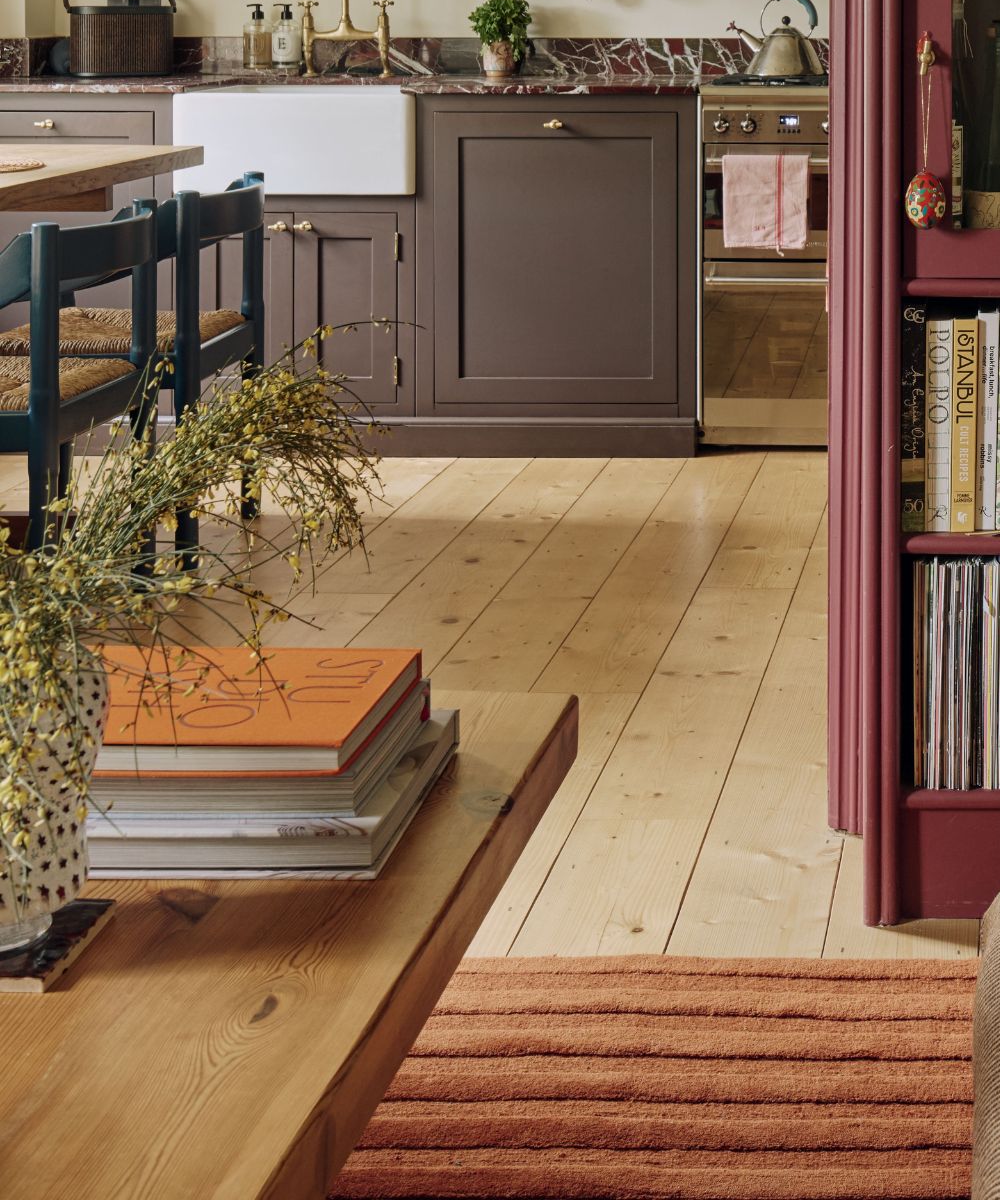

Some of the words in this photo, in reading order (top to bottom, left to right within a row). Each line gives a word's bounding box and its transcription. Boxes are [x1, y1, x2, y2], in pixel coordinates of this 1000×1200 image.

[928, 328, 950, 424] POLPO
[956, 329, 974, 424] ISTANBUL
[959, 426, 968, 446] CULT
[959, 448, 968, 482] RECIPES
[904, 499, 923, 513] 50
